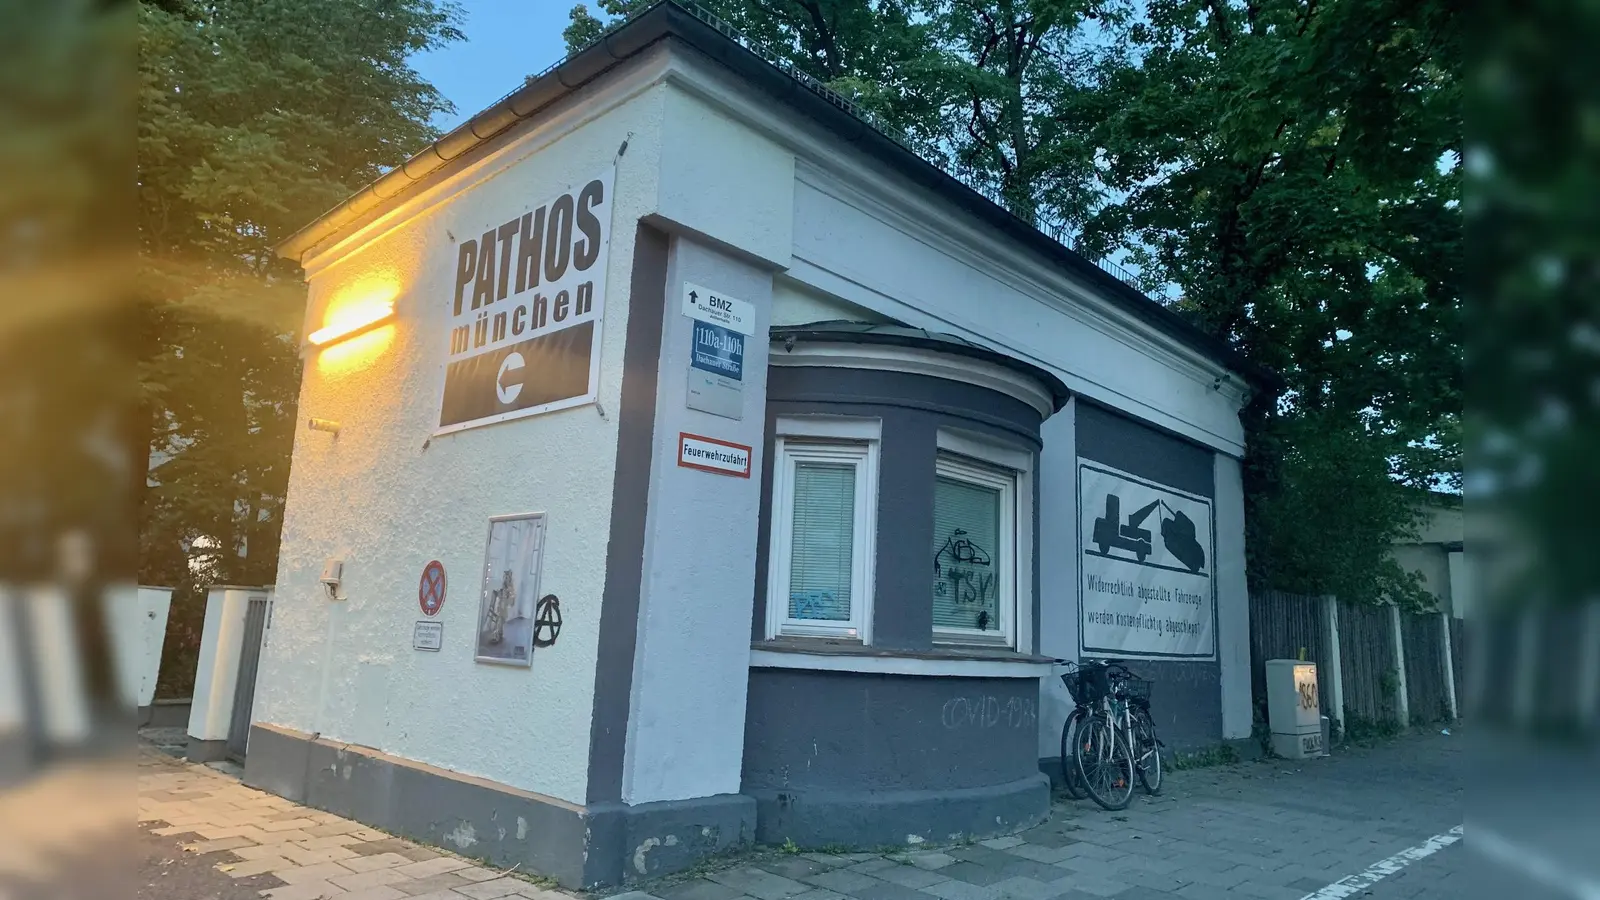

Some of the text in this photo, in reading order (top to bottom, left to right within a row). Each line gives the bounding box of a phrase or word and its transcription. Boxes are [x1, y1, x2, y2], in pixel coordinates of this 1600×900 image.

[453, 179, 604, 317] PATHOS
[450, 280, 594, 355] münchen
[709, 295, 732, 313] BMZ
[733, 315, 742, 323] 110
[699, 327, 742, 356] 110a-110h
[695, 353, 740, 374] Dachauer Straße
[683, 443, 747, 467] Feuerwehrzufahrt
[1087, 573, 1202, 610] Widerrechtlich abgestellte Fahrzeuge
[1088, 609, 1201, 638] werden kostenpflichtig abgeschleppt
